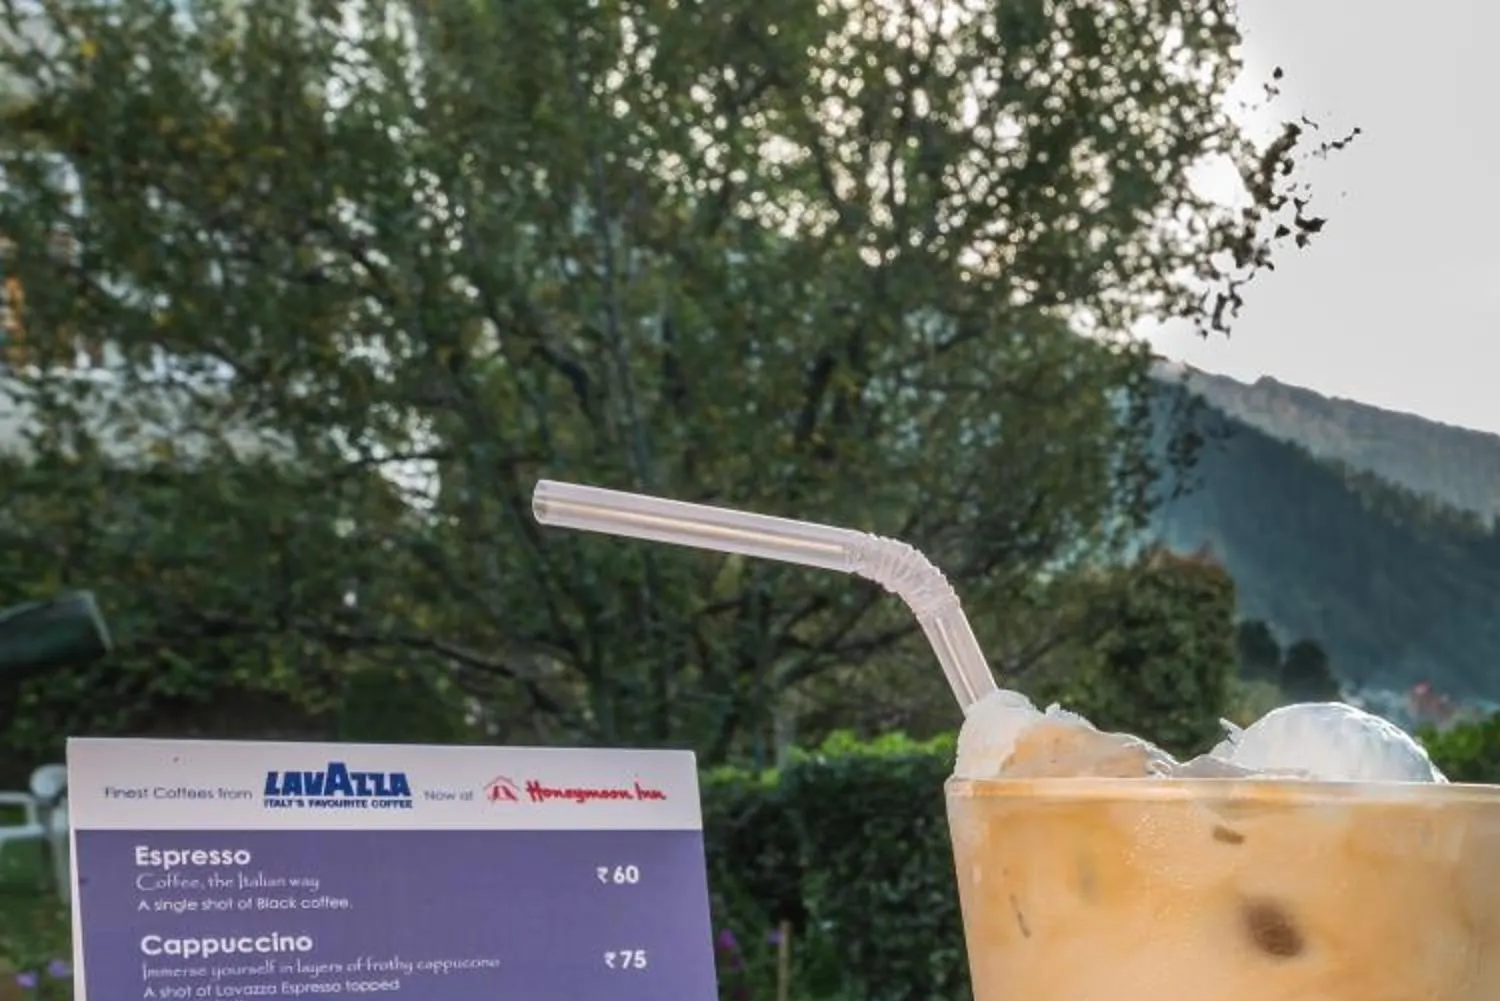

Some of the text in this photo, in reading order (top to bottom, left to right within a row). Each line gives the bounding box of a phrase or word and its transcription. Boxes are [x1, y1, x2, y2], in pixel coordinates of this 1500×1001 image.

[264, 762, 412, 797] LAVAZZA
[104, 786, 253, 800] Finest Coffees from
[424, 790, 456, 801] Now
[526, 779, 667, 803] Honeymoon Inn
[371, 800, 413, 809] COFFEE
[135, 845, 251, 870] Espresso
[208, 872, 233, 889] the
[238, 871, 286, 889] Italian
[289, 878, 320, 892] way
[138, 900, 150, 911] A
[154, 899, 198, 914] single
[201, 898, 233, 911] shot
[237, 898, 252, 910] of
[257, 897, 297, 910] Black
[140, 931, 314, 959] Cappuccino
[211, 959, 276, 980] yourself
[279, 961, 293, 974] in
[297, 958, 343, 977] layers
[366, 955, 413, 975] frothy
[143, 979, 400, 998] A shot of Lavazza Espresso topped
